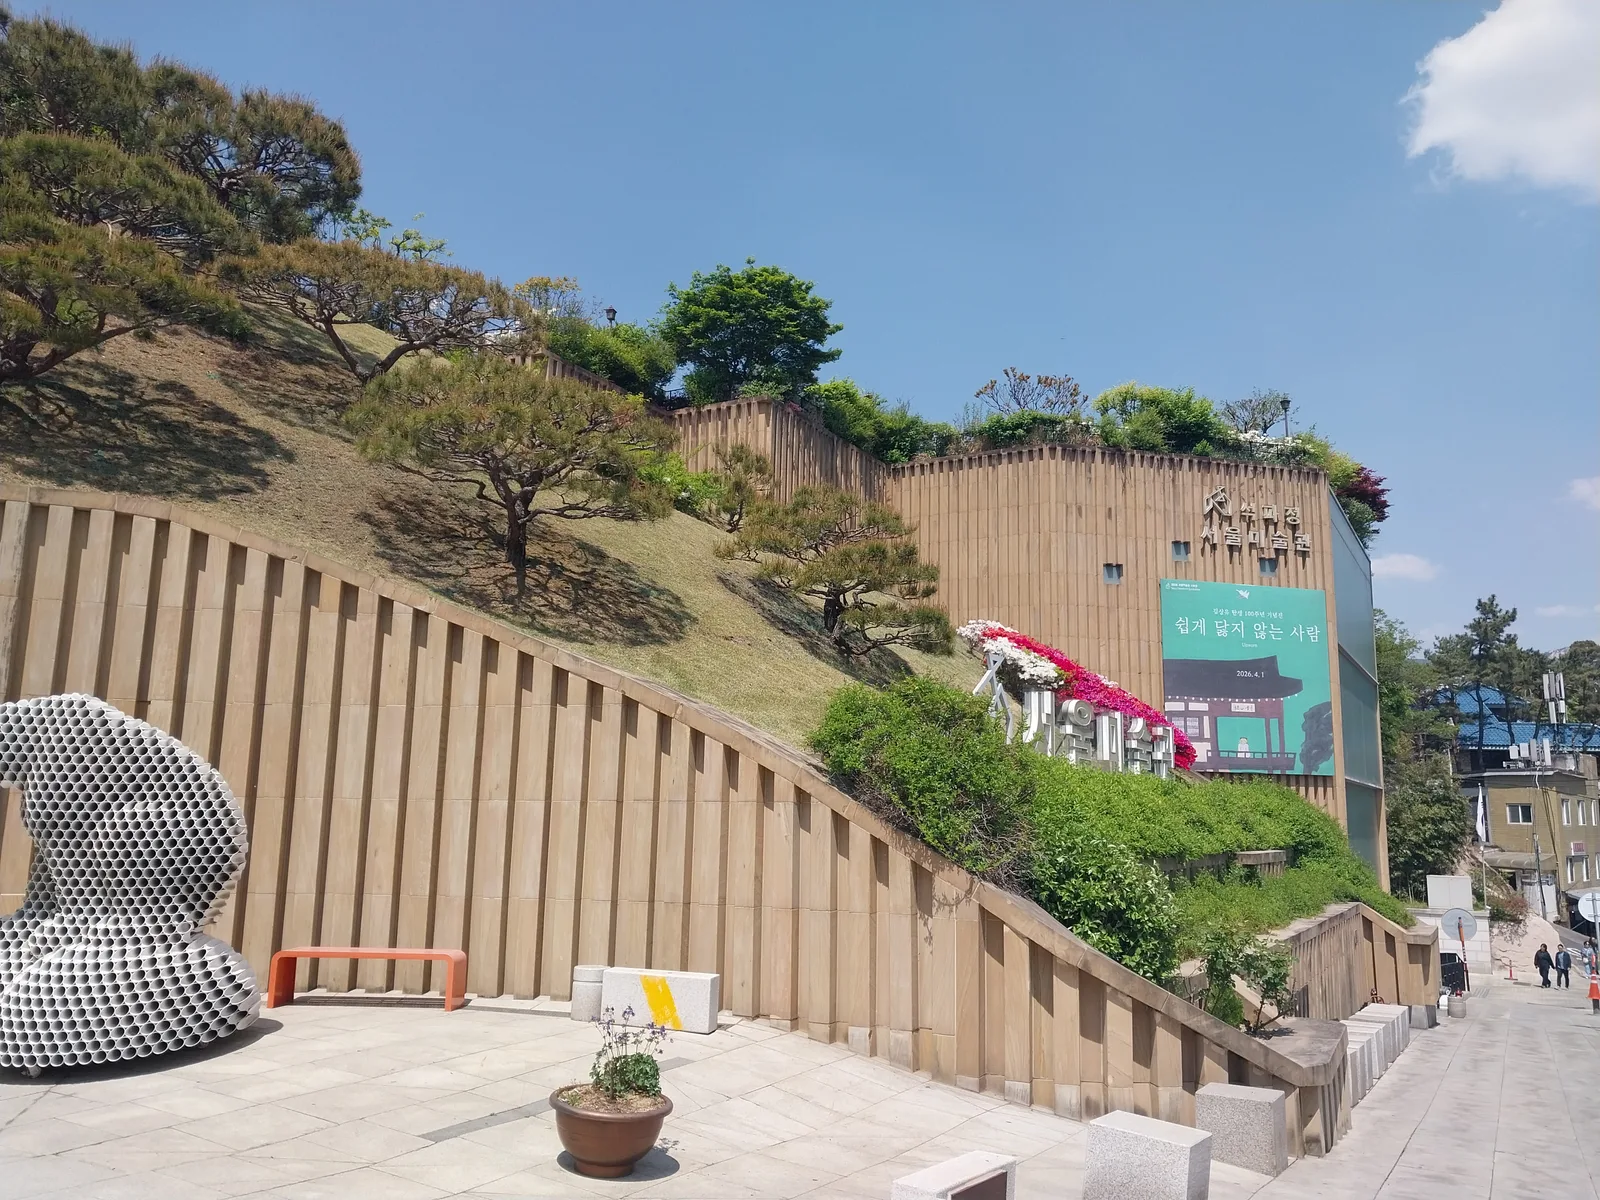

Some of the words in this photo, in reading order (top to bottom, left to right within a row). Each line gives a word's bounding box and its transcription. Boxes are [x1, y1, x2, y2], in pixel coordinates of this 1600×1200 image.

[1240, 502, 1300, 525] 석파정
[1200, 525, 1311, 551] 서울미술관
[1244, 610, 1266, 618] 100주년
[1174, 616, 1206, 637] 쉽게
[1213, 619, 1245, 639] 닳지
[1253, 621, 1284, 641] 않는
[1289, 623, 1321, 643] 사람
